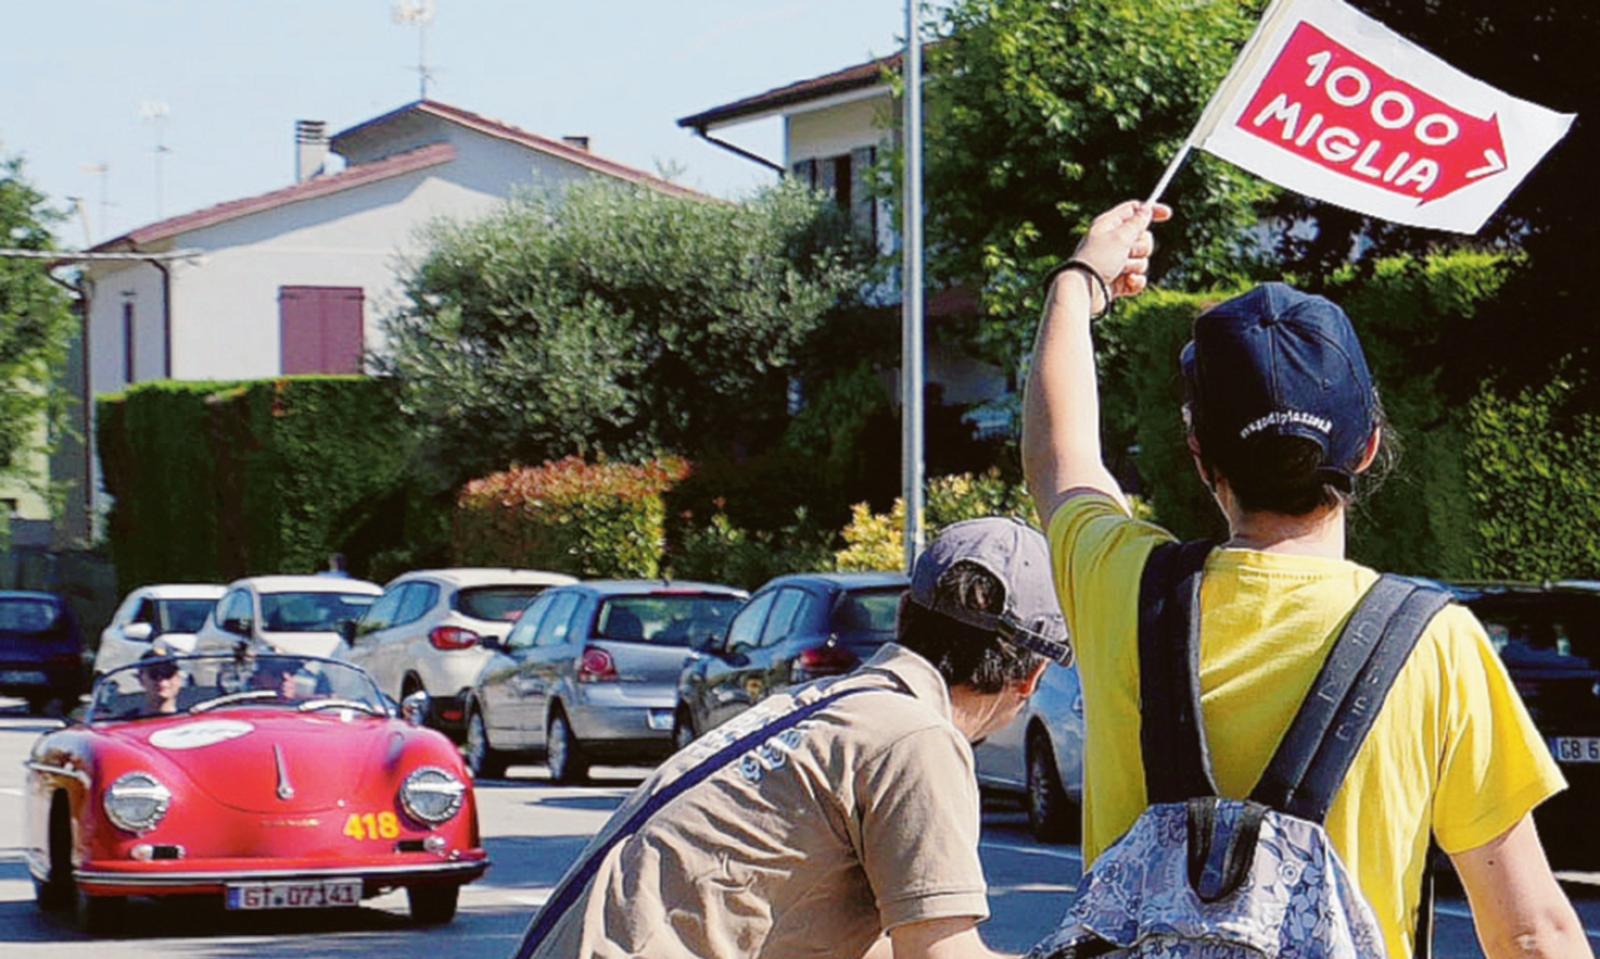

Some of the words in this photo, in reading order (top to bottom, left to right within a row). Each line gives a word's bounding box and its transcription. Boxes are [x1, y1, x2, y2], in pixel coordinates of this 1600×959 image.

[1253, 93, 1439, 192] MIGLIA
[1305, 51, 1459, 145] 1000
[343, 811, 399, 841] 418
